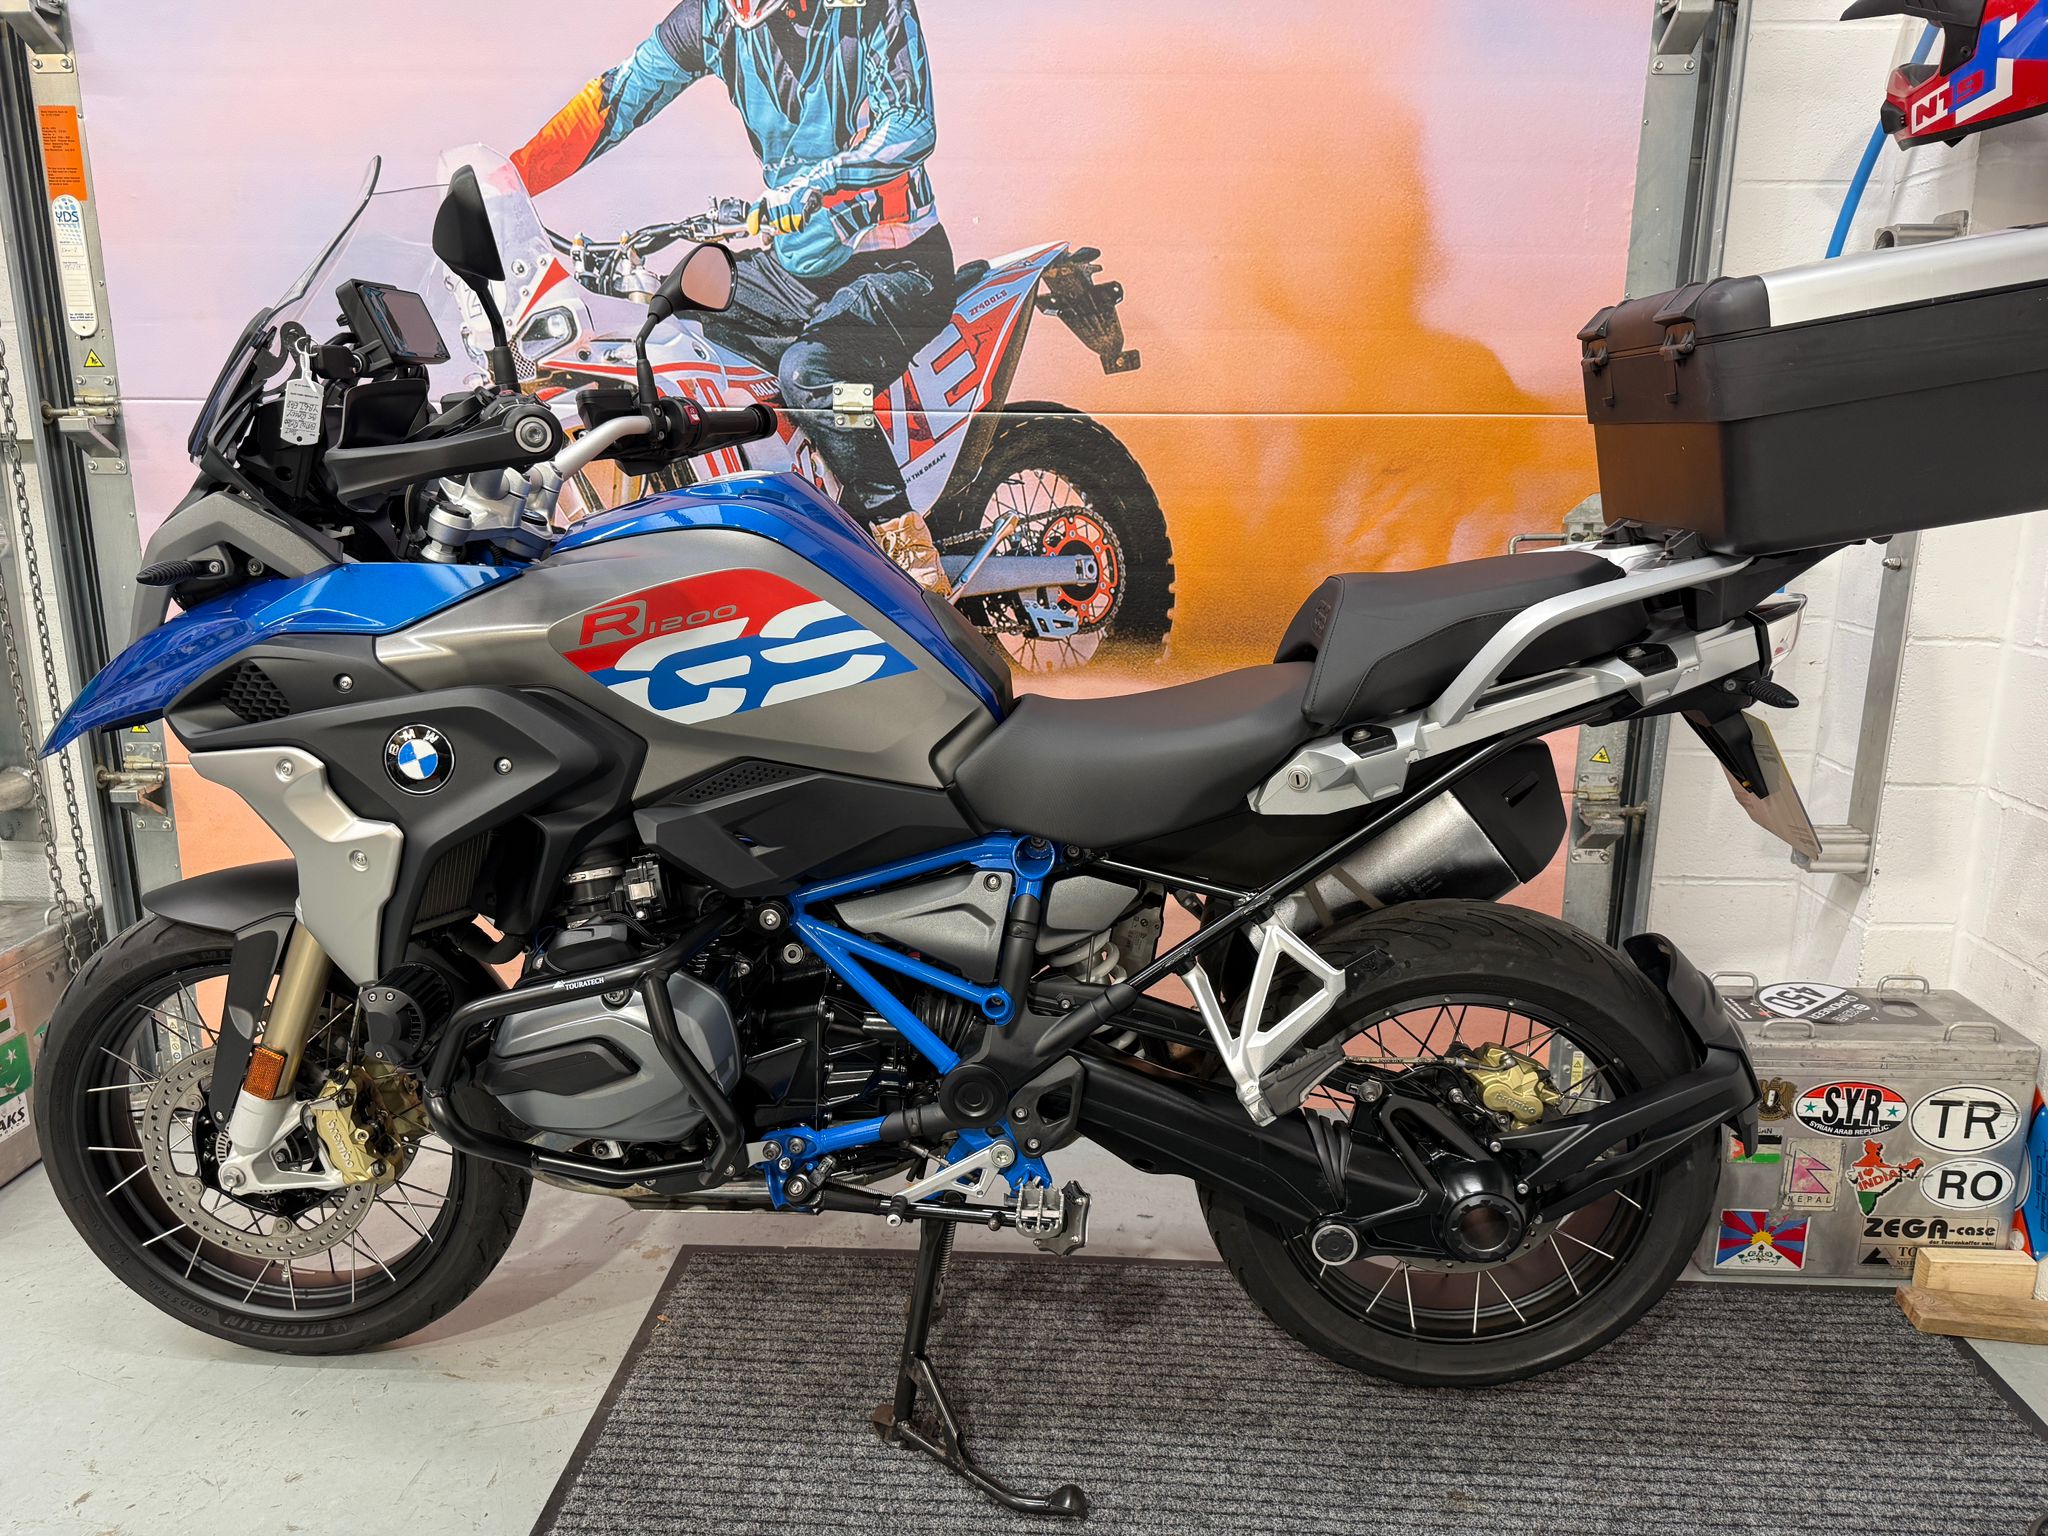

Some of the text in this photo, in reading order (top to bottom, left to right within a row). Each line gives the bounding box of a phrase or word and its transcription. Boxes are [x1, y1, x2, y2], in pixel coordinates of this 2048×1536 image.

[55, 211, 79, 222] YDS
[911, 469, 924, 481] THE
[923, 452, 947, 472] DREAM
[578, 600, 737, 650] R 1200
[607, 599, 887, 725] GS
[389, 728, 440, 756] BMW
[565, 977, 605, 990] TOURATECH
[1763, 986, 1826, 1010] 450
[1821, 1086, 1882, 1127] SYR
[1809, 1121, 1890, 1135] SYRIAN ARAB REPUBLIC
[1929, 1099, 2001, 1139] TR
[1857, 1171, 1864, 1180] I
[1857, 1169, 1899, 1191] INDIA
[1938, 1169, 2003, 1201] RO
[1787, 1195, 1832, 1204] NEPAL
[223, 1314, 325, 1337] MICHELIN
